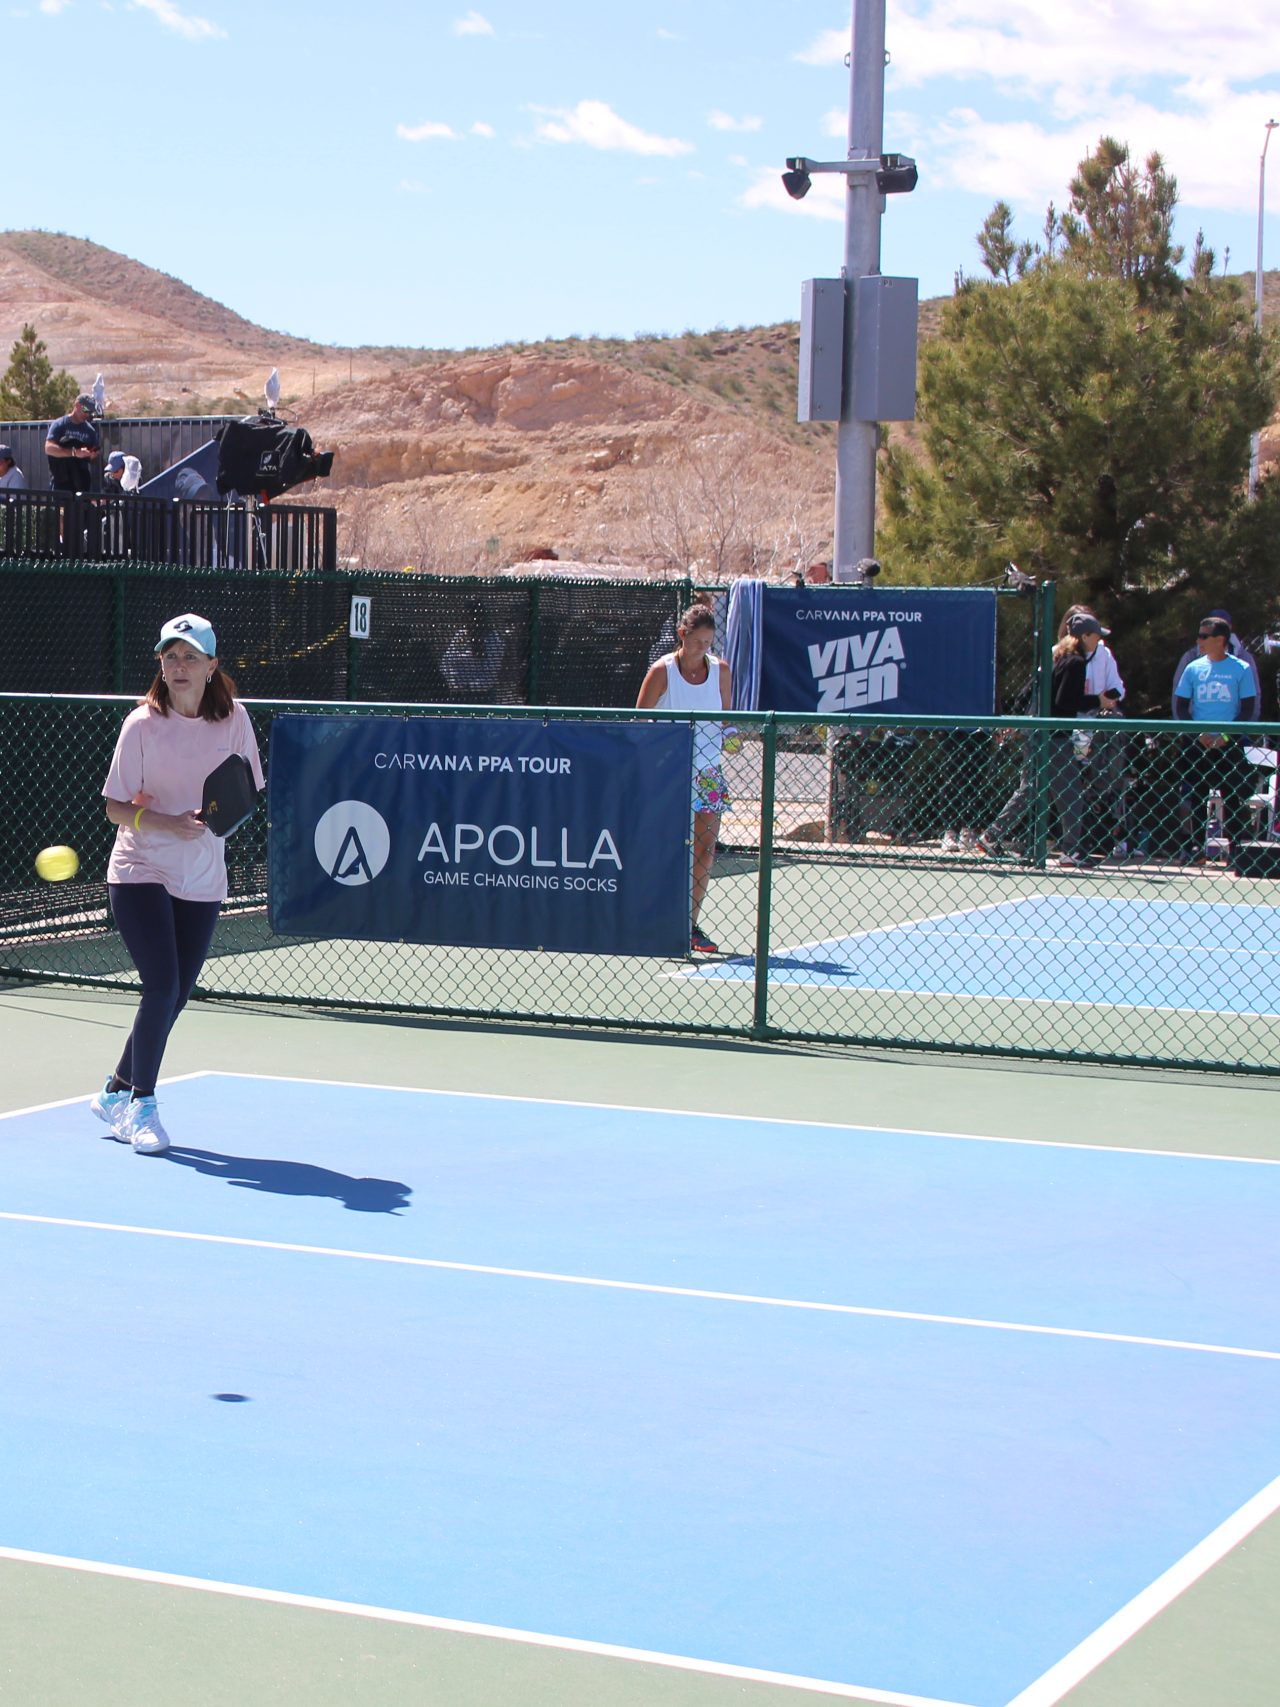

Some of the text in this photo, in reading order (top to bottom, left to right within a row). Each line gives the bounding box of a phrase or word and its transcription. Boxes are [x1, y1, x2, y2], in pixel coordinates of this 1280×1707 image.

[354, 602, 367, 633] 18
[795, 609, 923, 623] CARVANA PPA TOUR
[807, 626, 905, 679] VIVA
[1197, 680, 1232, 700] PPA
[374, 752, 571, 774] CARVANA PPA TOUR
[417, 822, 623, 871] APOLLA
[423, 871, 618, 893] GAME CHANGING SOCKS
